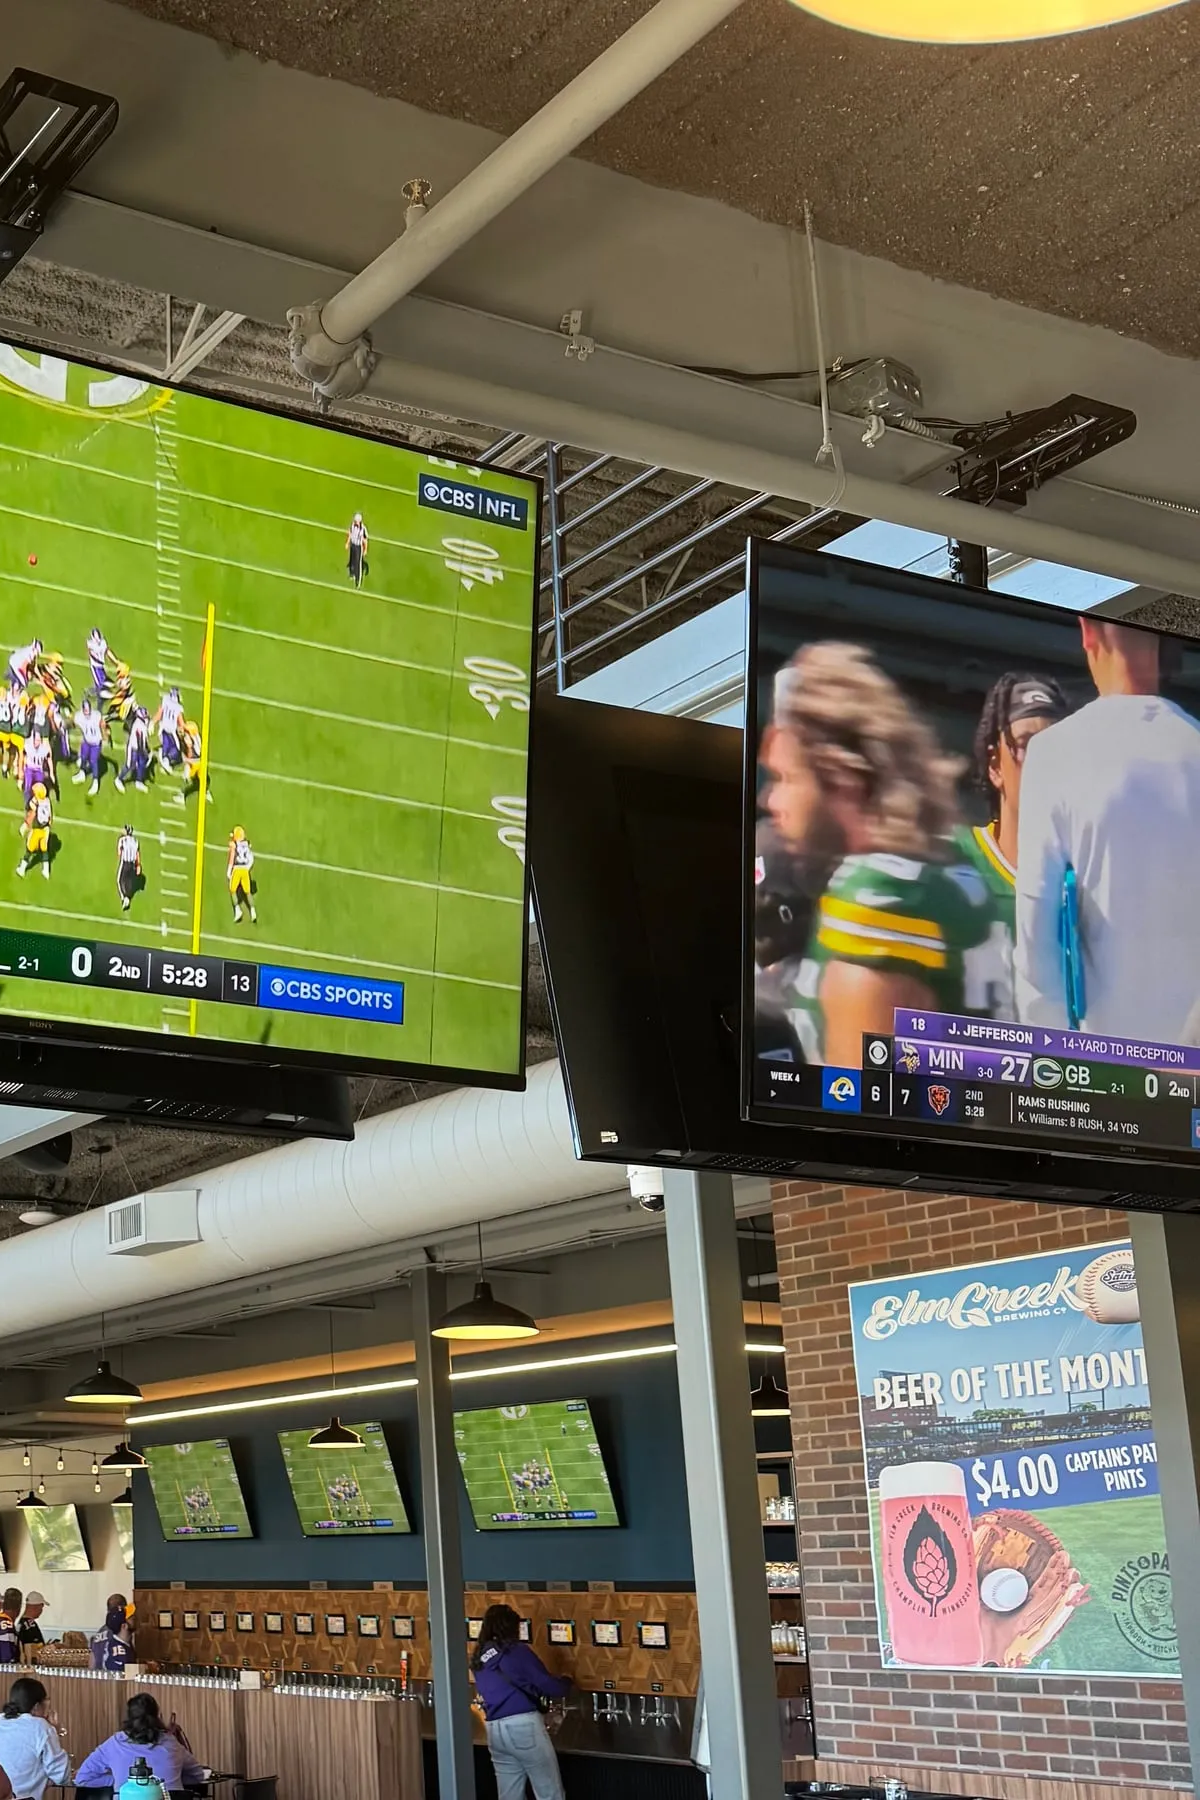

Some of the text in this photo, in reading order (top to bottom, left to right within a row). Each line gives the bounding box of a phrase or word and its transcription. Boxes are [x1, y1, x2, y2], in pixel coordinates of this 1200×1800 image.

[440, 486, 521, 522] CBS NFL
[17, 955, 40, 972] 2-1
[70, 946, 92, 978] 0
[108, 956, 141, 980] 2ND
[161, 963, 208, 988] 5:28
[230, 975, 250, 992] 13
[286, 980, 393, 1010] CBS SPORTS
[911, 1018, 1034, 1045] 18 J. JEFFERSON
[928, 1047, 964, 1071] MIN
[1061, 1037, 1185, 1064] 14-YARD TD RECEPTION
[770, 1070, 800, 1083] WEEK 4
[977, 1066, 994, 1079] 3-0
[1000, 1056, 1030, 1084] 27
[1065, 1064, 1091, 1086] GB
[871, 1085, 881, 1102] 6
[901, 1089, 910, 1105] 7
[965, 1089, 984, 1102] 2ND
[1111, 1083, 1125, 1095] 2-1
[1144, 1073, 1159, 1098] 0
[1168, 1081, 1190, 1098] 2ND
[1018, 1095, 1090, 1113] RAMS RUSHING
[1018, 1111, 1139, 1135] K. Williams: 8 RUSH, 34 YDS
[994, 1308, 1051, 1323] BREWING
[873, 1371, 944, 1412] BEER
[951, 1366, 986, 1401] OF
[995, 1358, 1053, 1399] THE
[1066, 1447, 1132, 1473] CAPTAINS
[972, 1452, 1059, 1507] $4.00
[1104, 1469, 1147, 1492] PINTS
